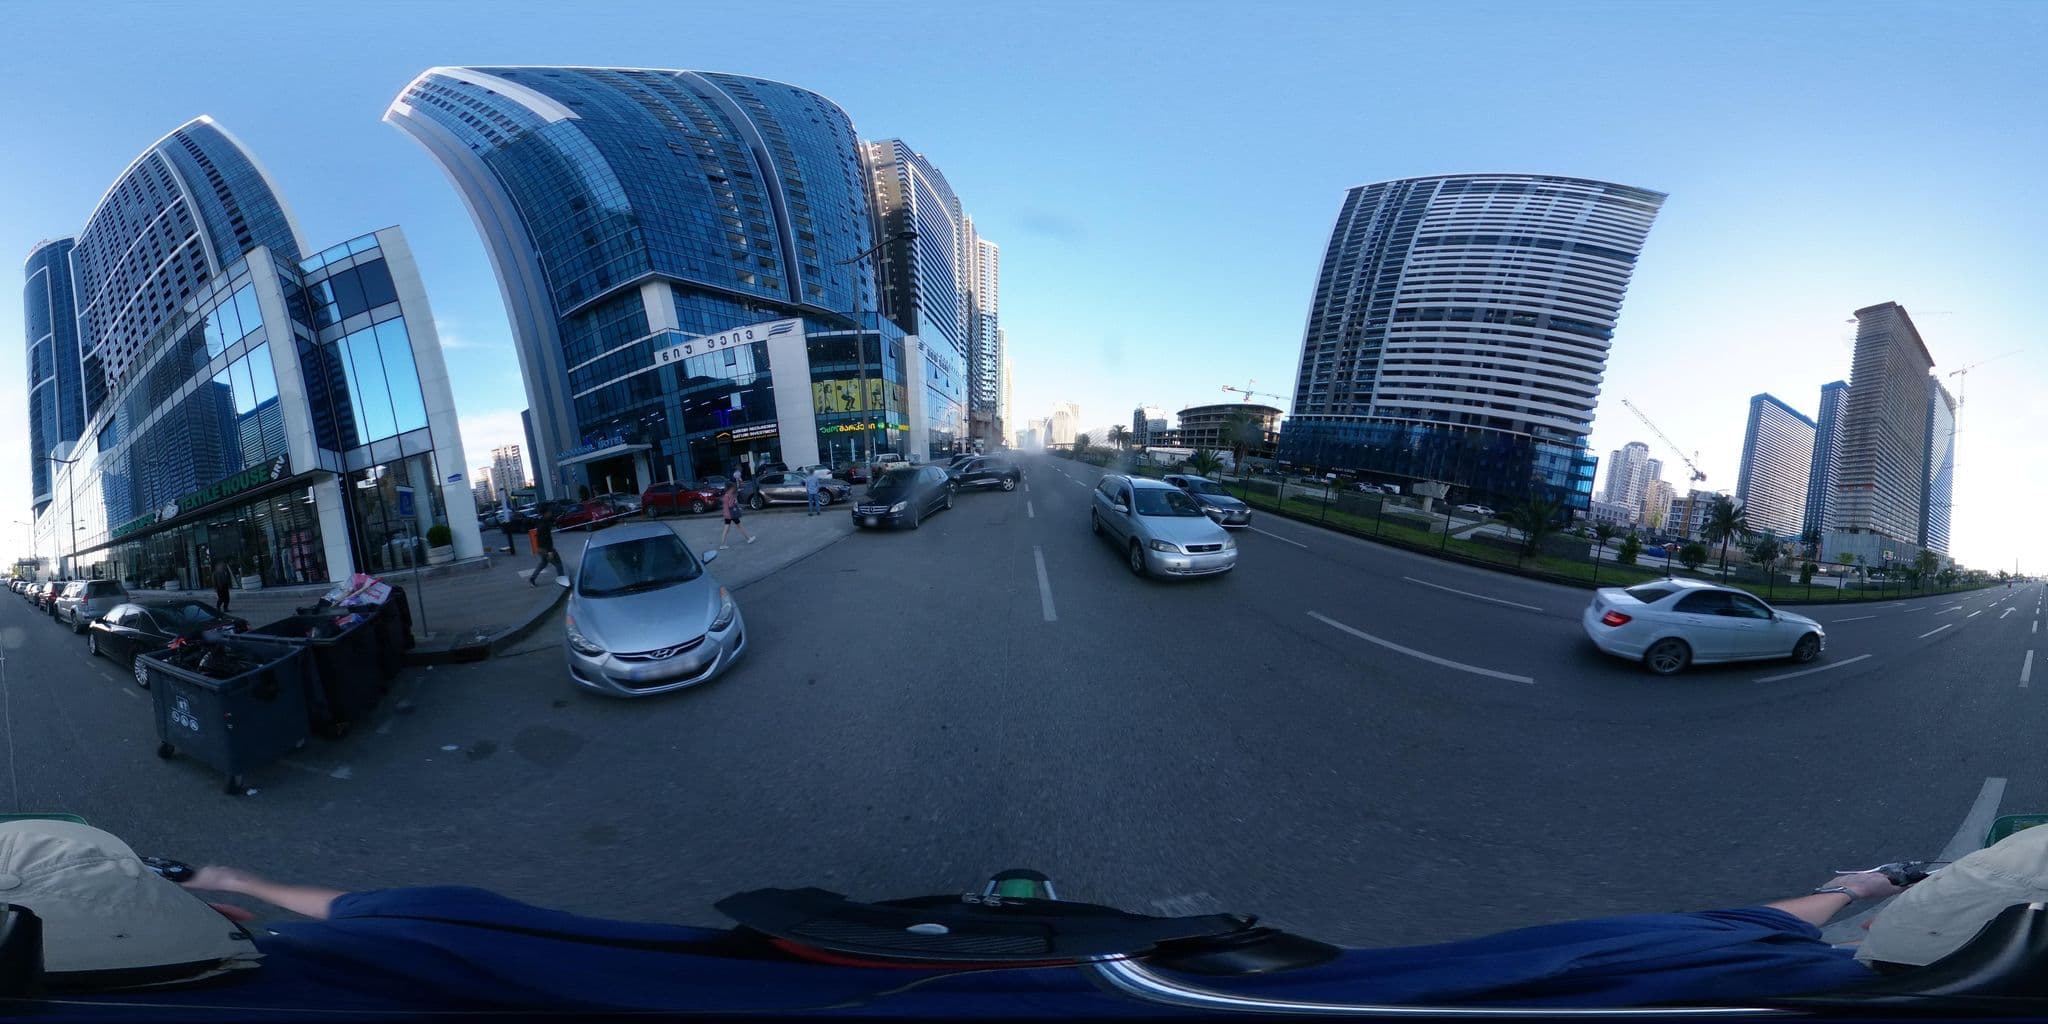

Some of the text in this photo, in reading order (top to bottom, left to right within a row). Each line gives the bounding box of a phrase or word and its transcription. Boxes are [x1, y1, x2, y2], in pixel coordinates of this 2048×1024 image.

[662, 329, 753, 361] ნიუ ვეივ
[179, 465, 270, 513] TEXTILE HOUSE
